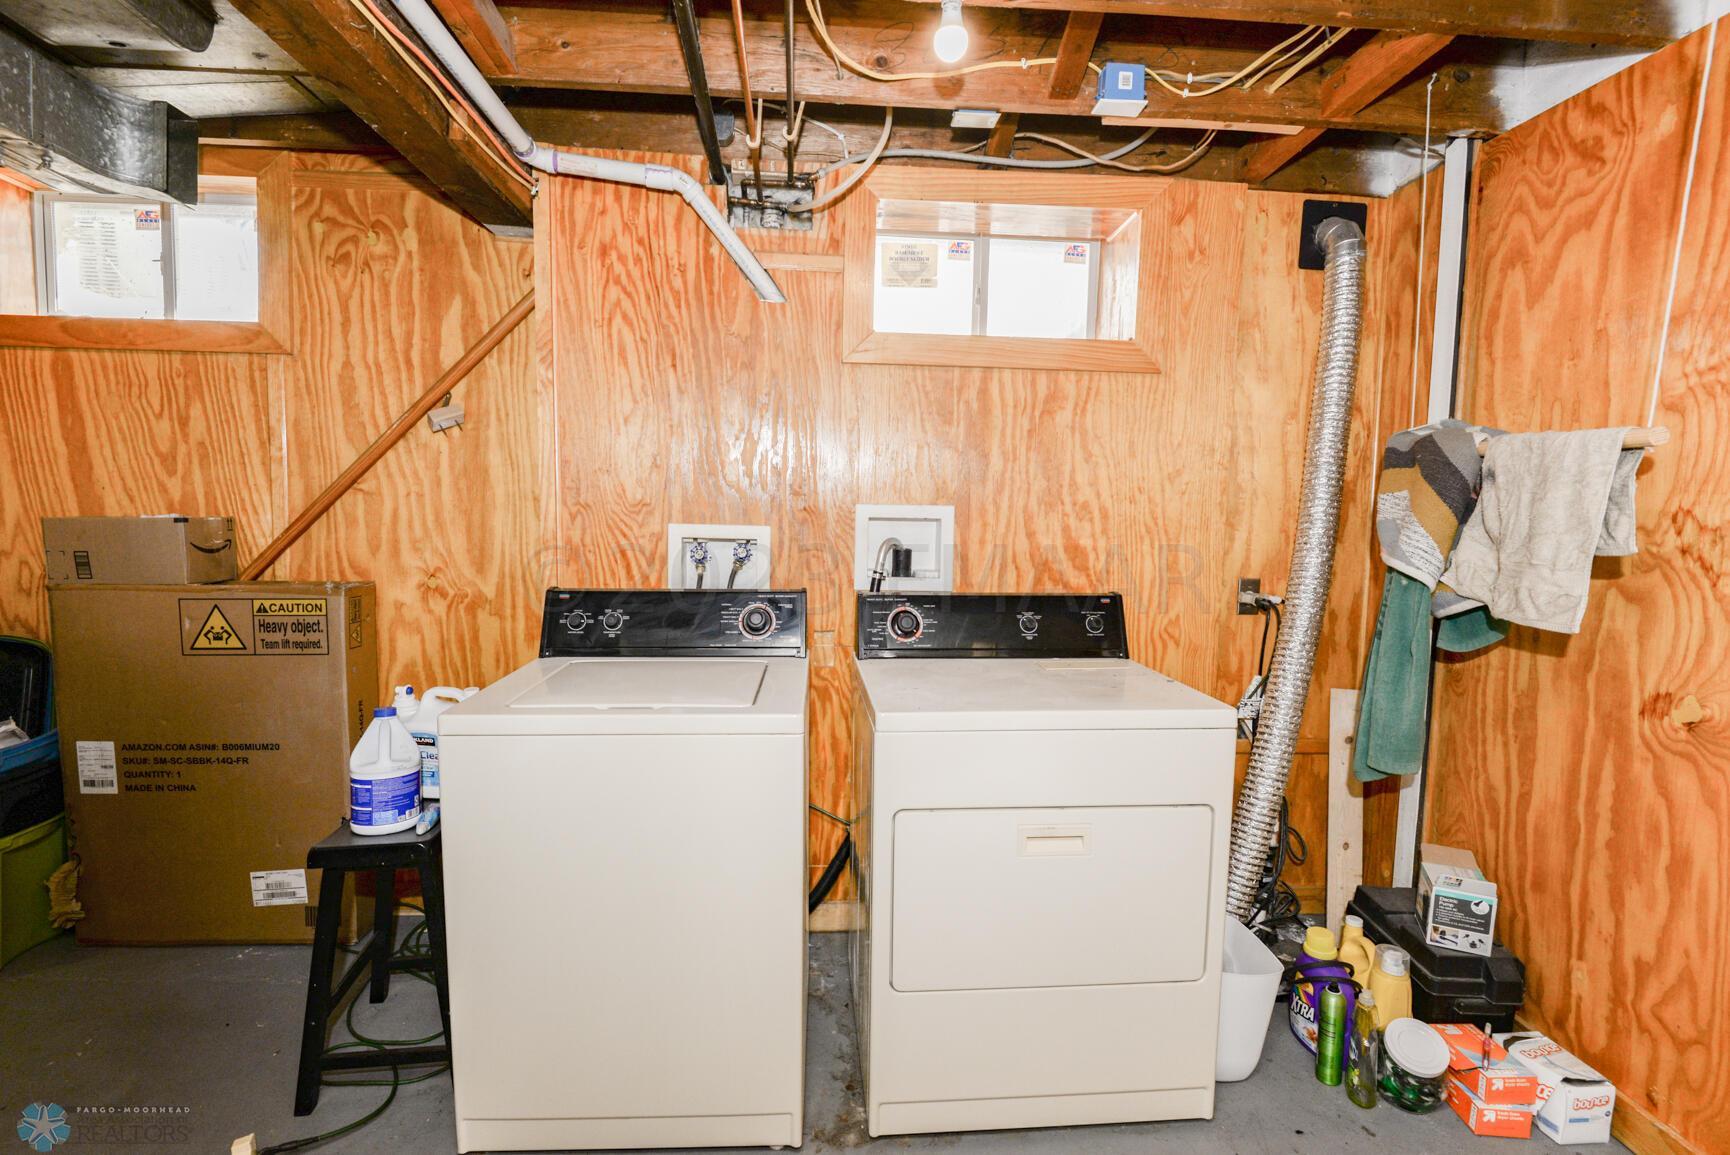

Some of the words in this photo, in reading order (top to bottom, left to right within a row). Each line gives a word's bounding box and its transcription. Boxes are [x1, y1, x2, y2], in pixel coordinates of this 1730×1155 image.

[268, 603, 323, 613] CAUTION
[258, 618, 289, 637] Heavy
[290, 618, 324, 637] object.
[260, 638, 280, 649] Team
[281, 638, 291, 649] lift
[292, 638, 323, 652] required.
[121, 743, 187, 751] AMAZON.COM
[189, 743, 218, 751] ASIN#:
[420, 751, 439, 760] Clea
[122, 757, 150, 765] SKU#:
[124, 771, 174, 779] QUANTITY:
[125, 784, 153, 792] MADE
[155, 784, 165, 792] IN
[167, 784, 197, 792] CHINA
[1290, 993, 1315, 1023] XTRA
[1520, 1043, 1562, 1059] bounce
[1573, 1096, 1610, 1111] bounce
